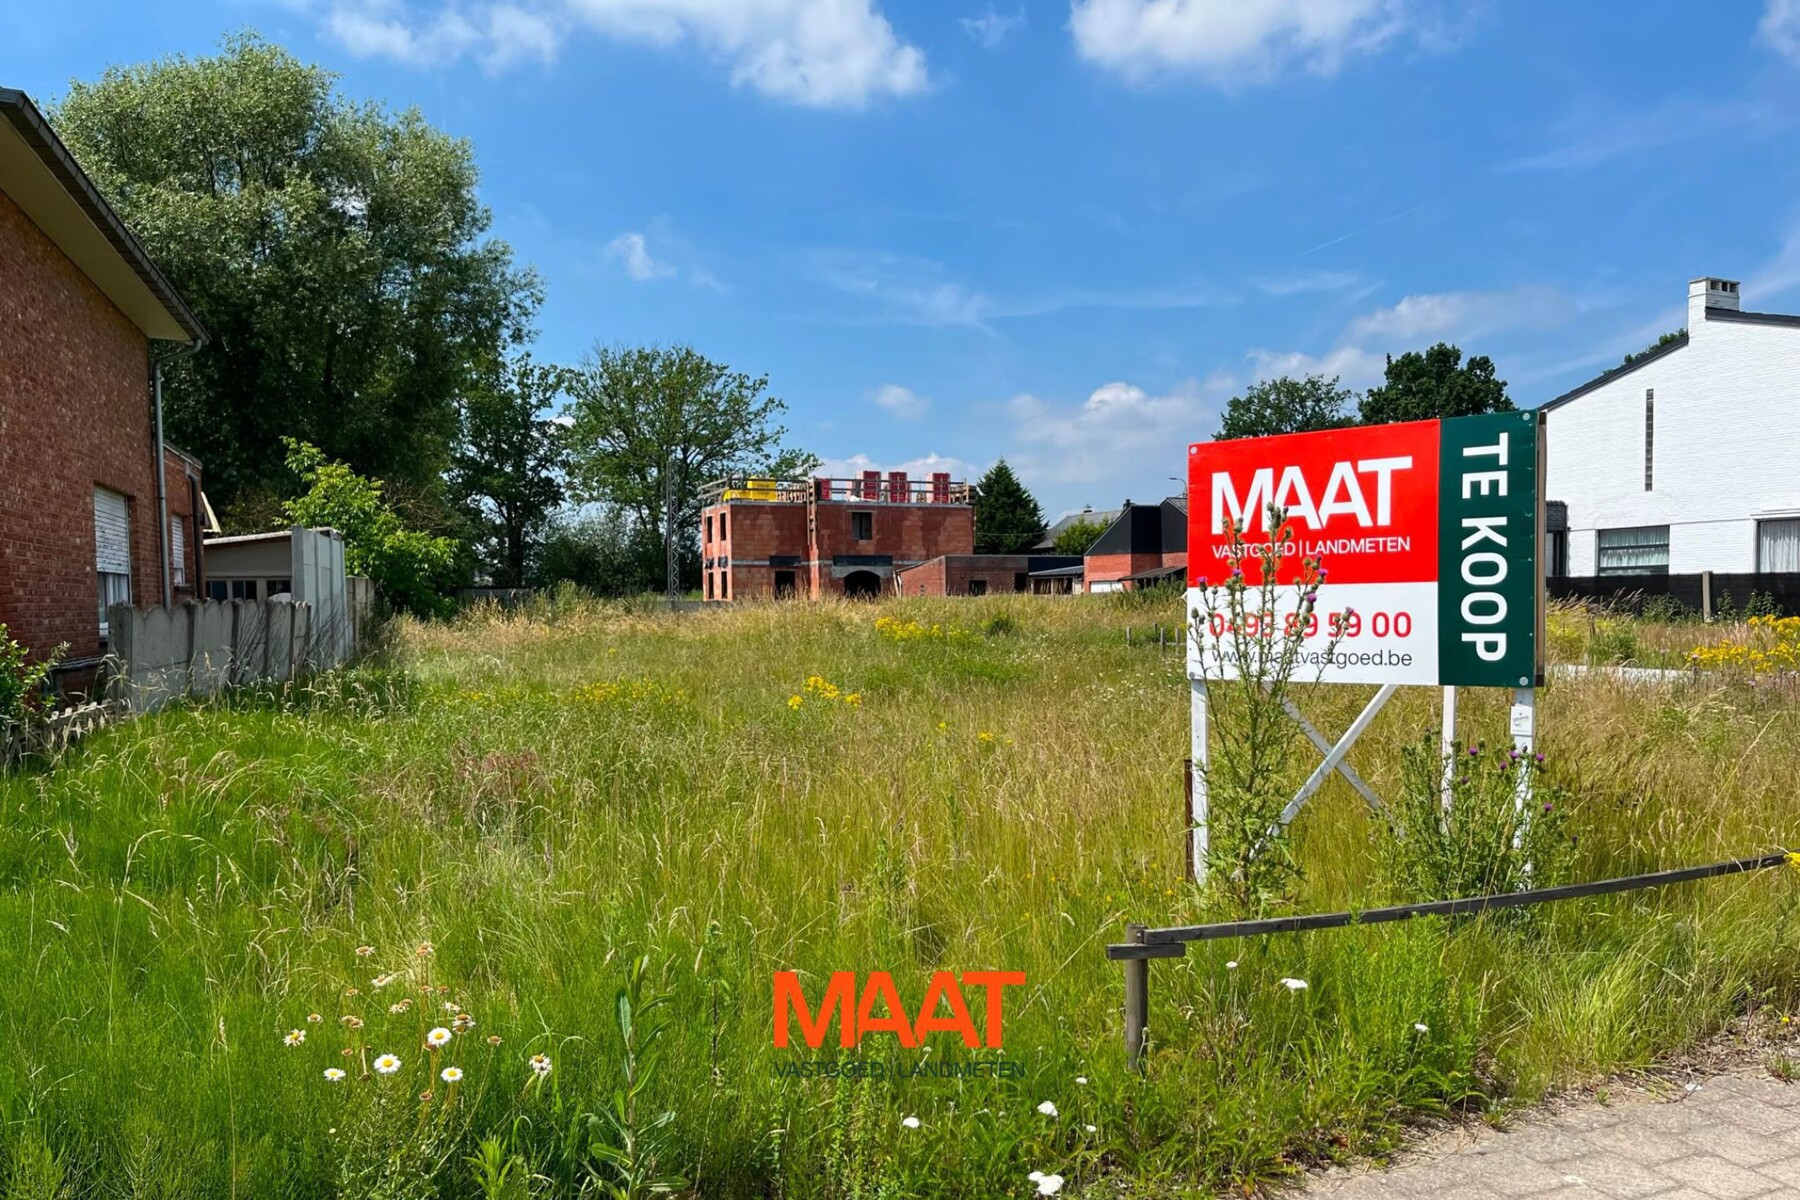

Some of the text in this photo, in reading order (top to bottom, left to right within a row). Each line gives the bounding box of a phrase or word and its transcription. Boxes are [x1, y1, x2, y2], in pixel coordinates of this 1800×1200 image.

[1211, 455, 1413, 535] MAAT
[1212, 536, 1411, 559] VASTGOED LANDMETEN
[1460, 431, 1509, 662] TE KOOP
[1283, 611, 1319, 637] 89
[1327, 611, 1362, 637] 59
[1371, 611, 1412, 638] 00
